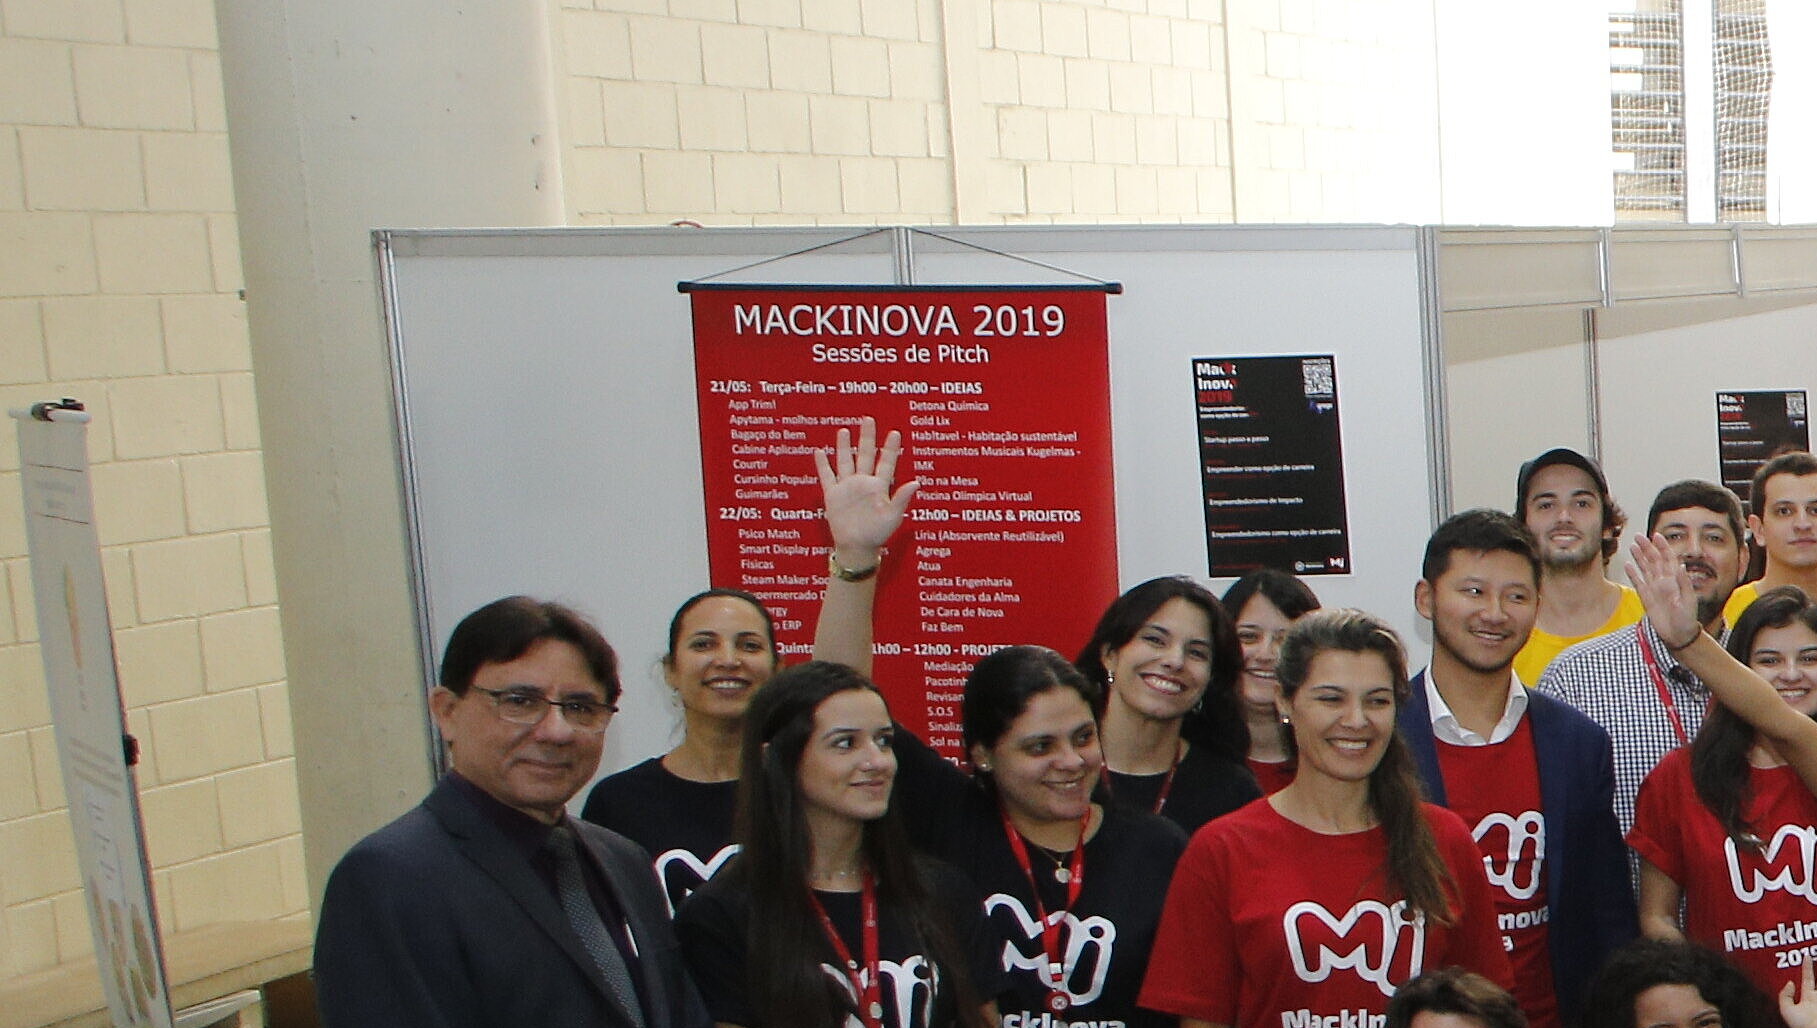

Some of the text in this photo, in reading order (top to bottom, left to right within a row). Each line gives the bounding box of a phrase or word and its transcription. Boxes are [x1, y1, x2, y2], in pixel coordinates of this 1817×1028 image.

[733, 304, 1065, 337] MACKINOVA 2019
[812, 342, 989, 363] Sessões de Pitch
[839, 381, 877, 394] 19h00
[890, 381, 928, 394] 20h00
[941, 382, 983, 395] IDEIAS
[820, 416, 864, 425] artesana
[910, 415, 934, 426] Gold
[768, 430, 781, 439] do
[783, 430, 806, 440] Bem
[732, 445, 766, 455] Cabine
[913, 446, 979, 456] Instrumentos
[981, 446, 1024, 456] Musicais
[734, 475, 818, 486] Cursinho Popular
[936, 478, 948, 486] na
[951, 476, 979, 486] Mesa
[735, 489, 789, 500] Guimarães
[916, 490, 950, 500] Piscina
[998, 490, 1033, 501] Virtual
[719, 507, 762, 520] 22/05:
[911, 509, 1081, 523] 12h00 IDEIAS & PROJETOS
[767, 528, 800, 539] Match
[739, 544, 771, 555] Smart
[774, 544, 809, 556] Display
[918, 561, 941, 571] Atua
[742, 575, 809, 586] Steam Maker
[956, 576, 1012, 589] Engenharia
[919, 591, 1020, 603] Cuidadores da Alma
[920, 607, 1004, 617] De Cara de Nova
[922, 622, 964, 633] Faz Bem
[873, 643, 900, 655] 1h00
[914, 643, 951, 656] 12h00
